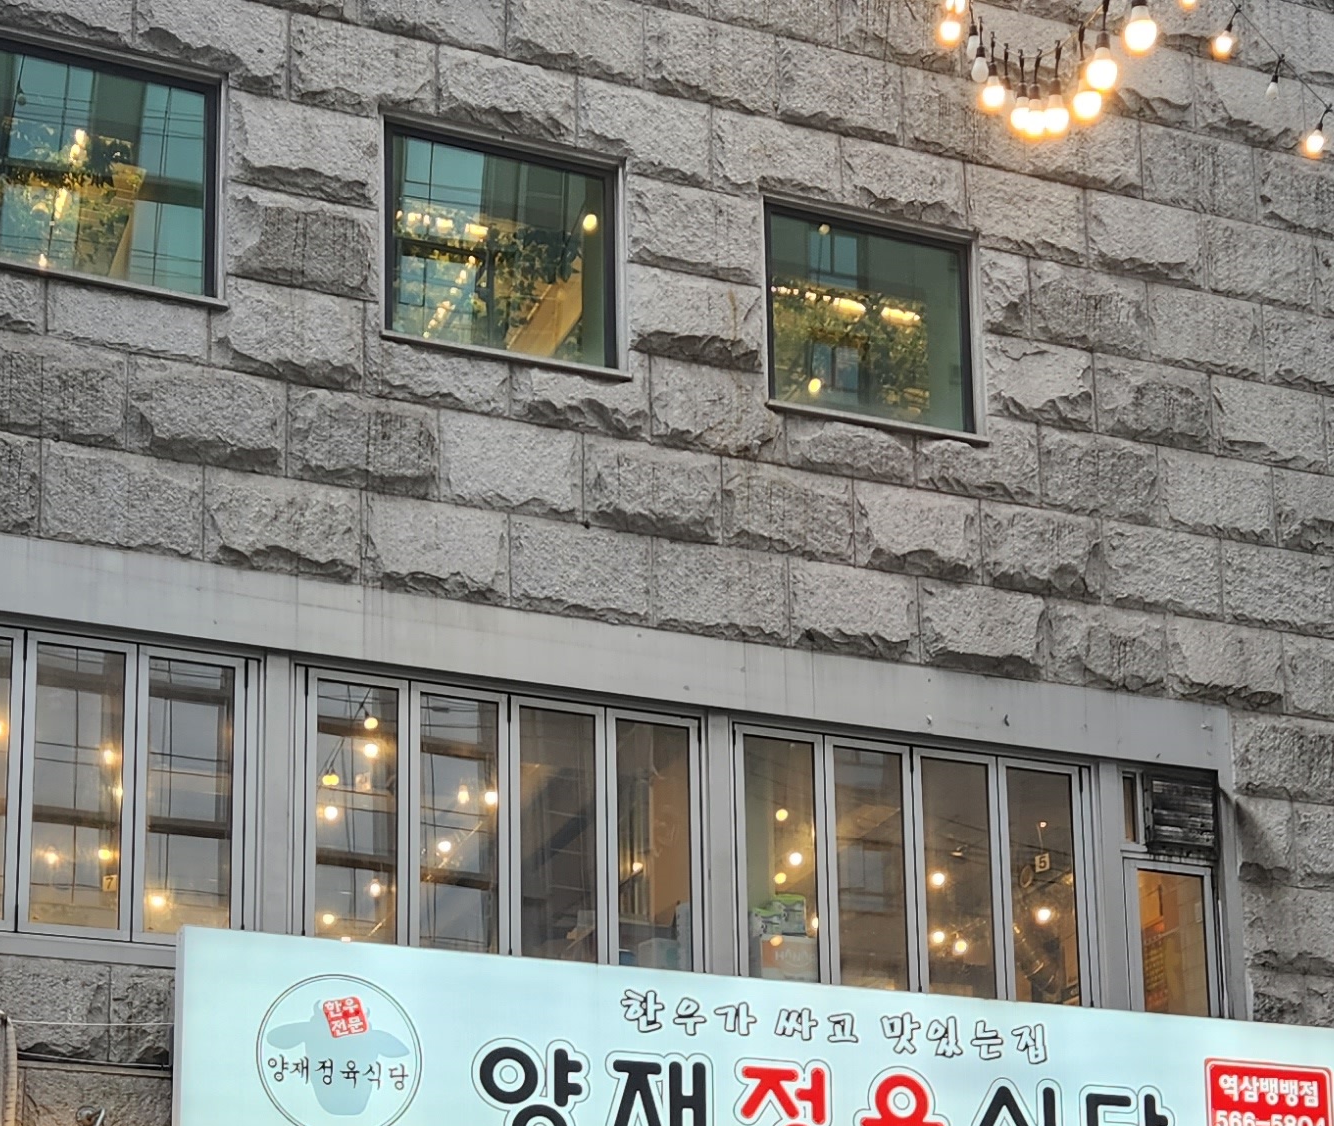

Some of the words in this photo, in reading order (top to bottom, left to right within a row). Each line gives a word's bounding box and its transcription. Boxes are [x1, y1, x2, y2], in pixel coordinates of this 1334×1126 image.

[1039, 856, 1047, 869] 5
[105, 876, 114, 890] 7
[323, 997, 362, 1018] 한우
[620, 989, 758, 1037] 한우가
[774, 1007, 860, 1044] 싸고
[329, 1015, 366, 1038] 전문
[267, 1054, 410, 1092] 양재정육식당
[1217, 1073, 1320, 1108] 역삼뱅뱅점
